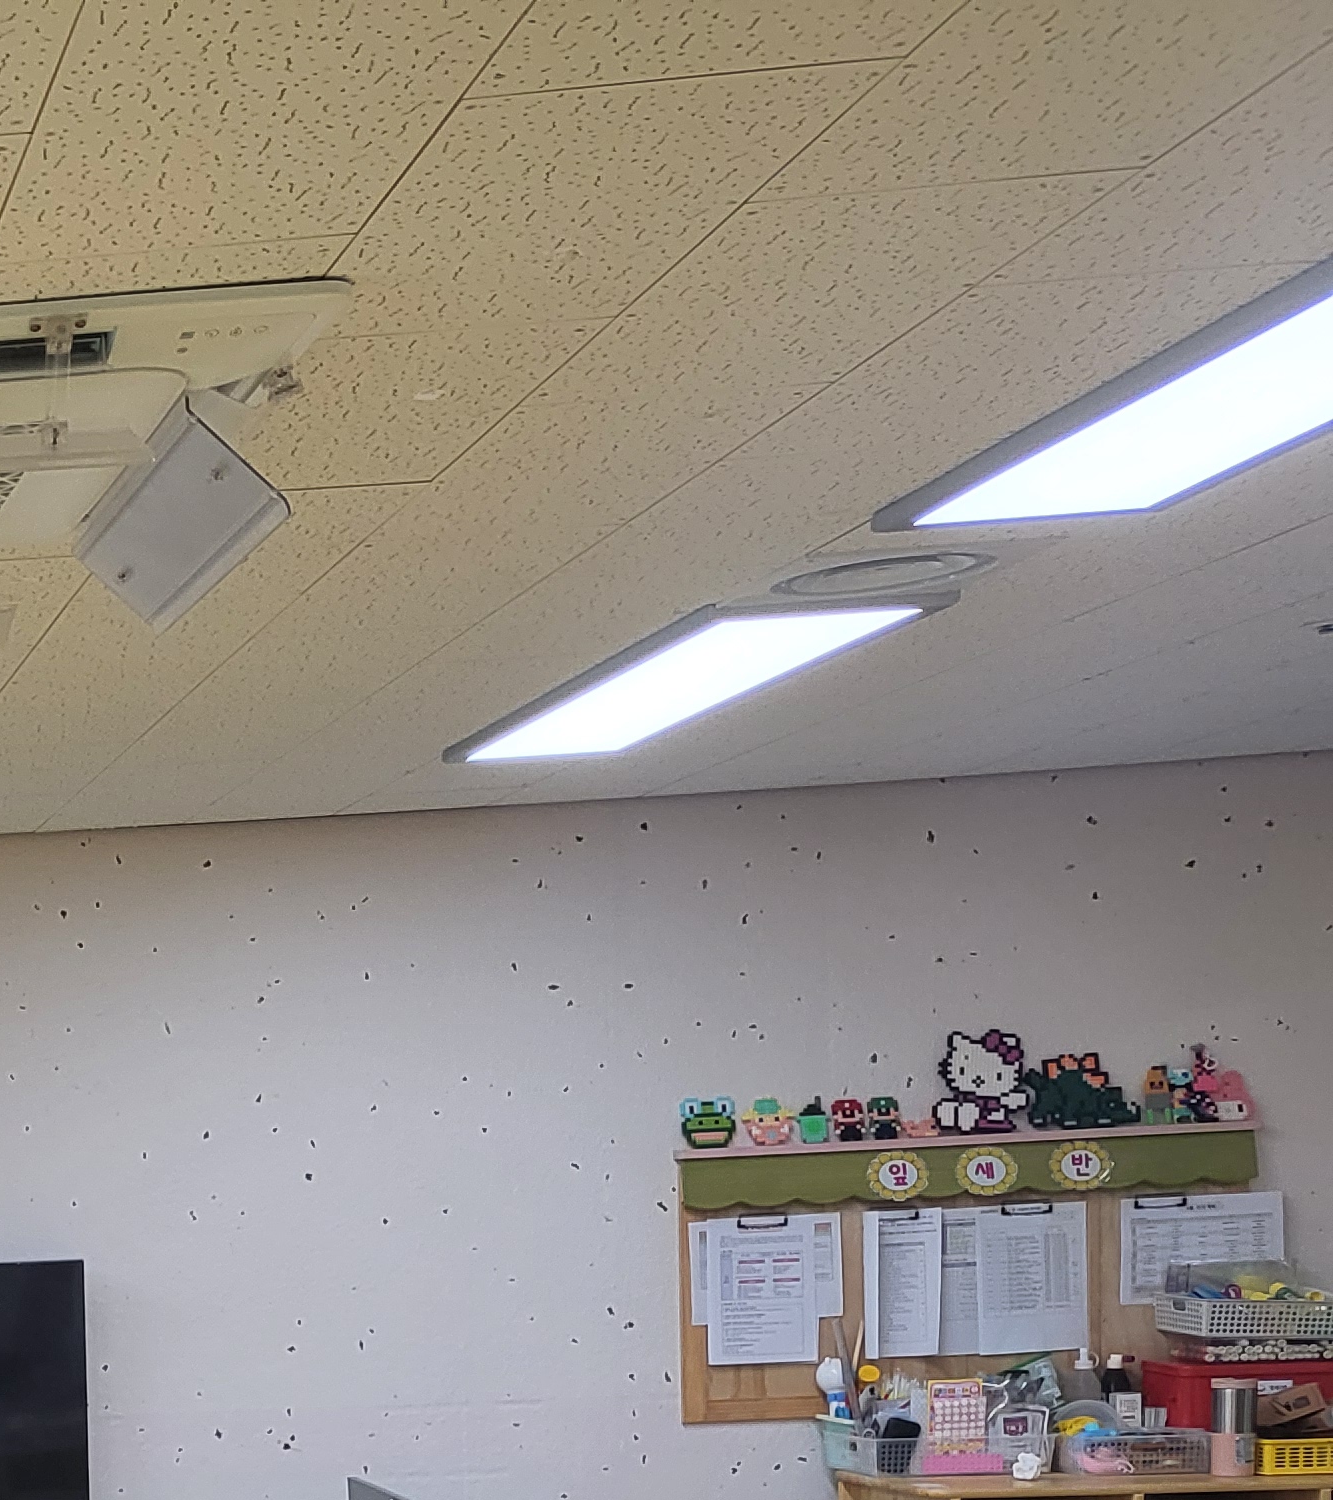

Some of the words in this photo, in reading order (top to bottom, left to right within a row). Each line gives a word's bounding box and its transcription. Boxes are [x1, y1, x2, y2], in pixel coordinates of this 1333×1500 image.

[888, 1163, 909, 1187] 잎
[974, 1161, 995, 1180] 새
[1071, 1153, 1093, 1178] 반
